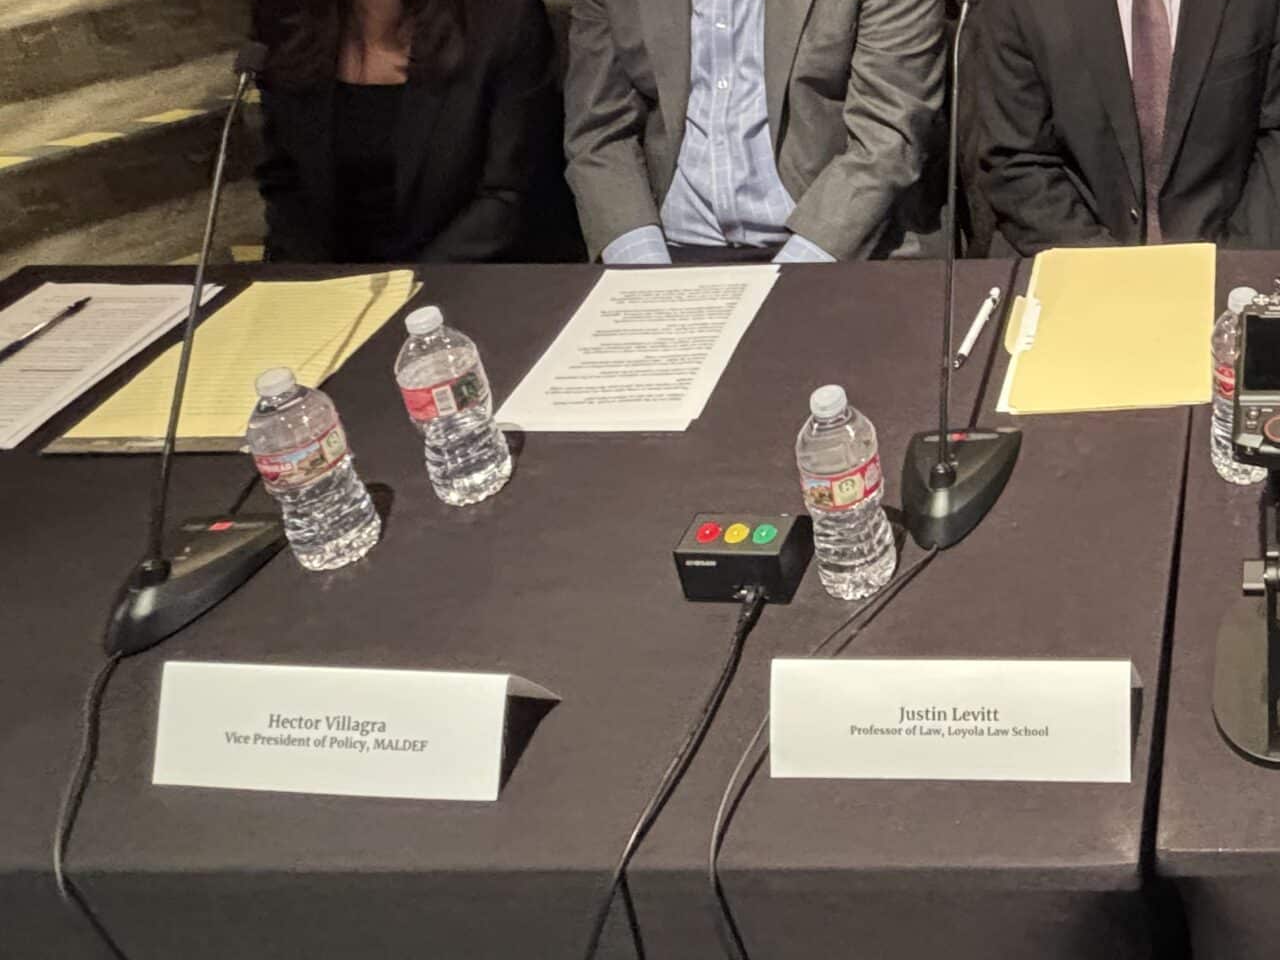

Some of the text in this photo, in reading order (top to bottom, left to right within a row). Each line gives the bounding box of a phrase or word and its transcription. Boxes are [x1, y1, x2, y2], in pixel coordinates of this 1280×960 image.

[268, 714, 387, 735] Hector Villagra
[898, 706, 1000, 724] Justin Levitt
[850, 725, 1049, 739] Professor of Law, Loyola Law School
[225, 731, 428, 753] Vice President of Policy, MALDEF
